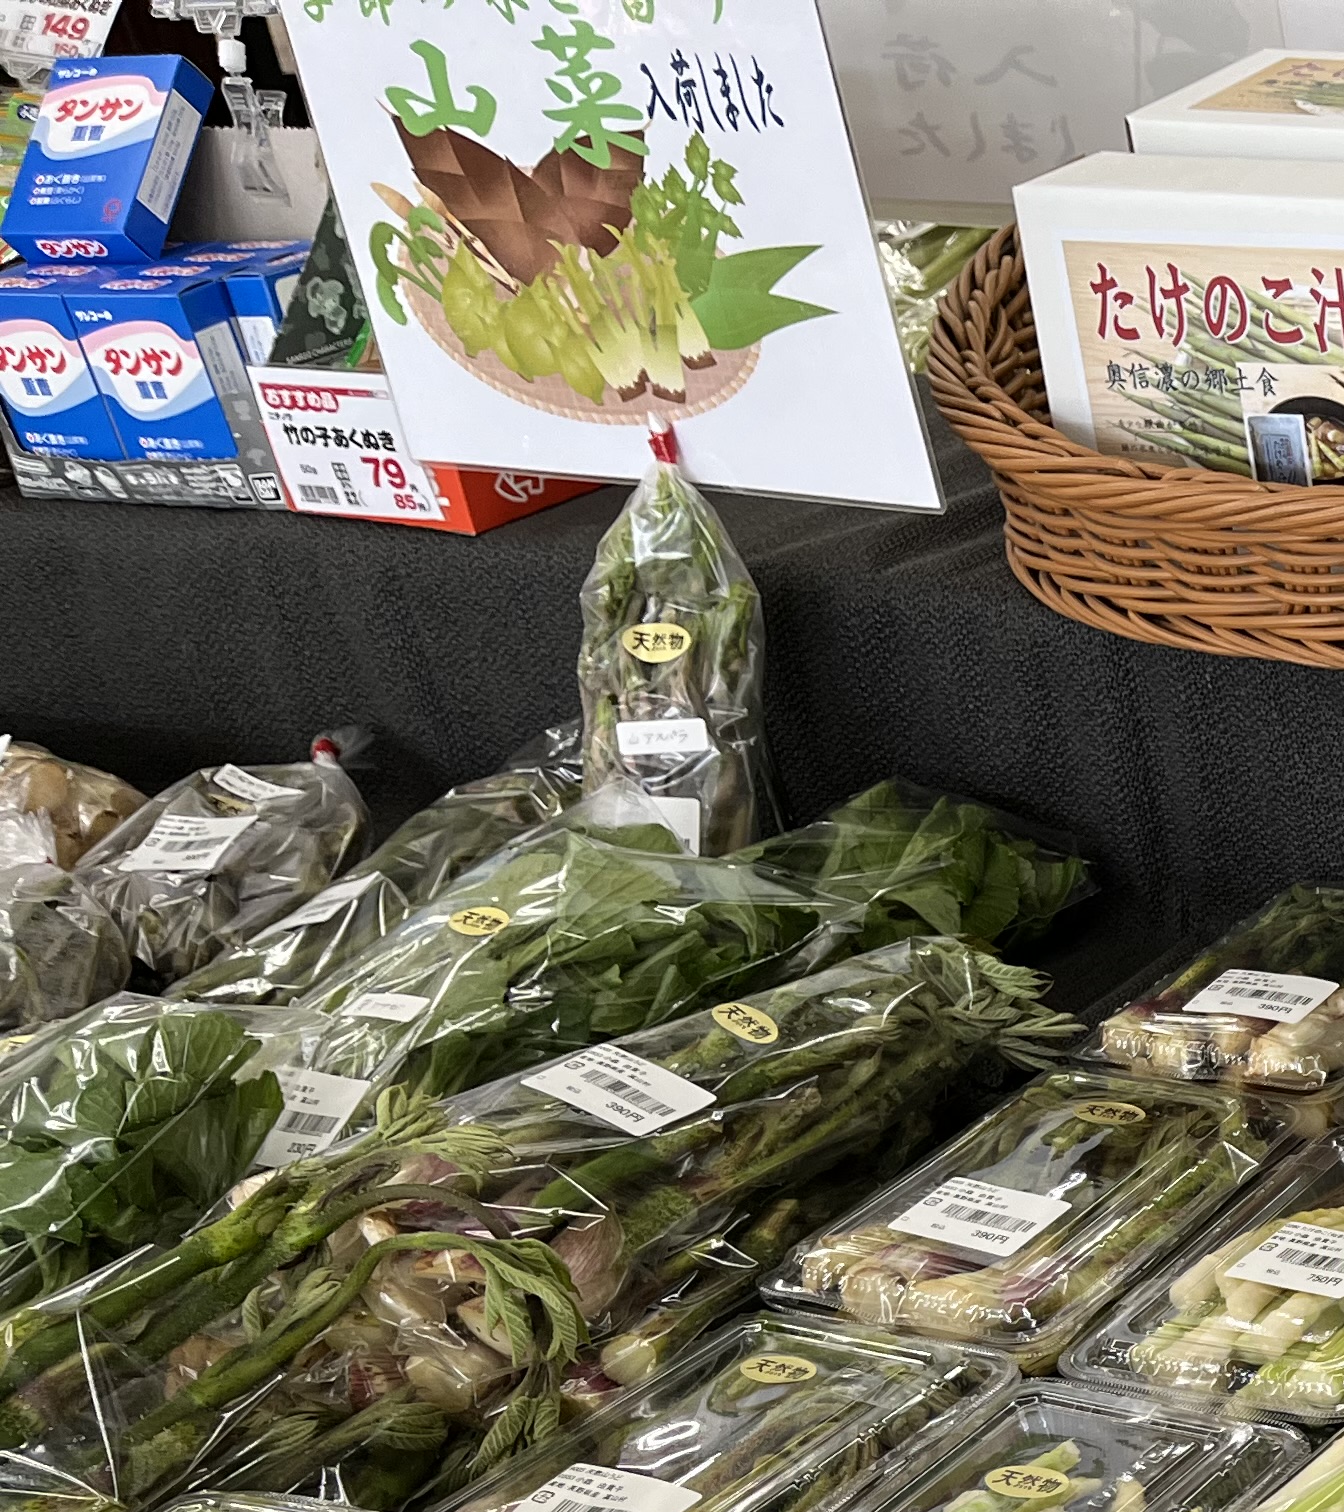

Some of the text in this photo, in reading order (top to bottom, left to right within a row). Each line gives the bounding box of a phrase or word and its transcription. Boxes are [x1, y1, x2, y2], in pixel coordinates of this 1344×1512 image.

[42, 13, 90, 40] 149
[385, 20, 785, 170] 山菜 入荷しました
[54, 97, 144, 123] タンサン
[104, 348, 184, 376] タンサン
[1106, 360, 1279, 397] 奥信濃の郷土食
[283, 424, 398, 452] 竹の子あくぬき
[633, 630, 684, 651] 天然物
[605, 1101, 645, 1123] 390円
[970, 1230, 1010, 1244] 390円
[1306, 1273, 1343, 1286] 750円
[992, 1470, 1062, 1494] 天然物
